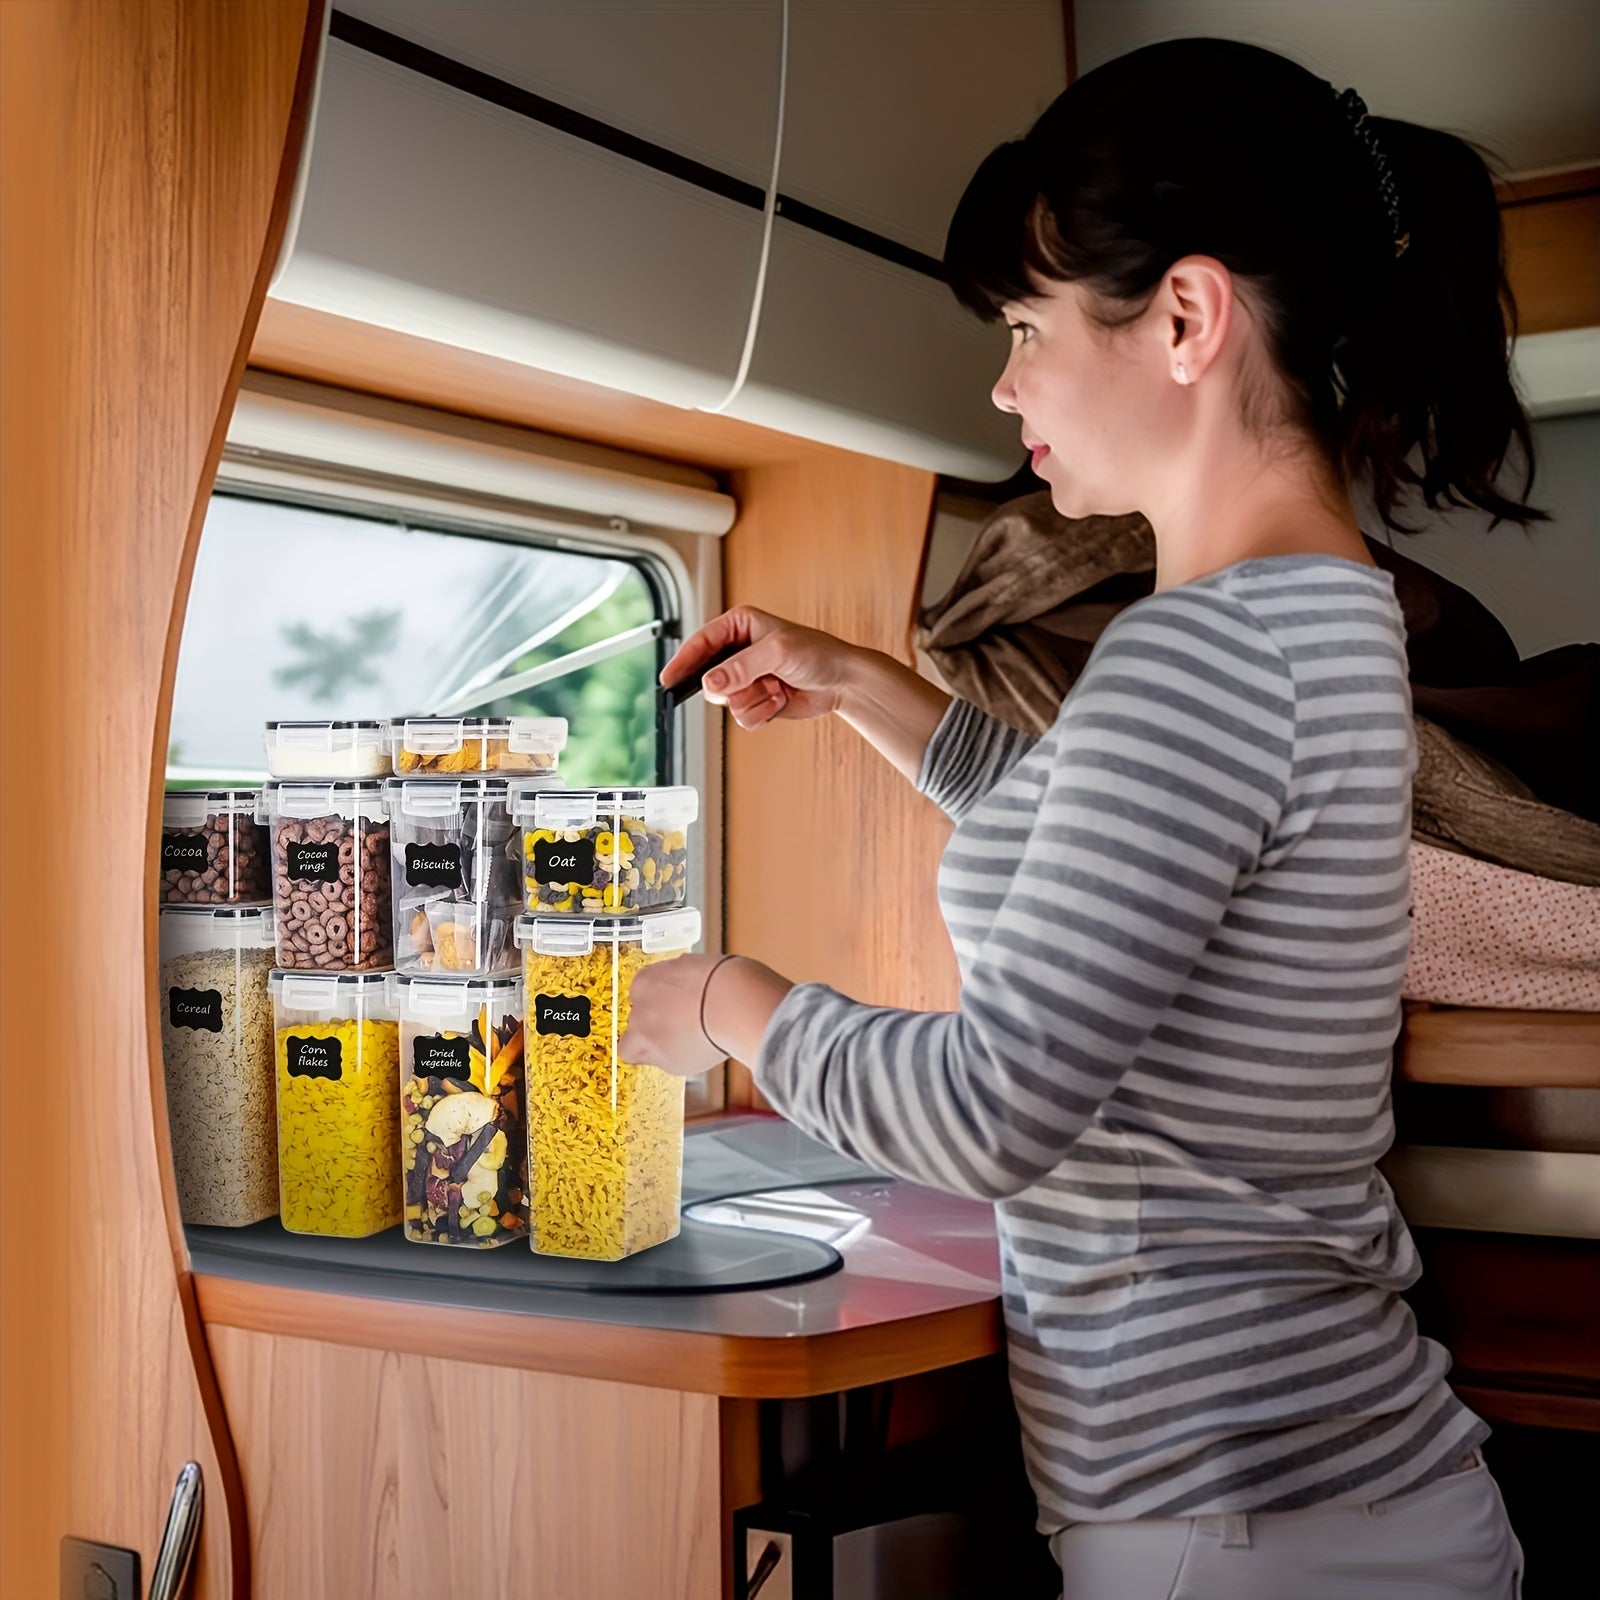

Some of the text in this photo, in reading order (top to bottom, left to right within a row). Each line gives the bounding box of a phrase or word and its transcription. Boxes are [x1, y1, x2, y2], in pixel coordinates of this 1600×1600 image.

[164, 845, 203, 858] Cocoa
[297, 850, 328, 860] Cocoa
[299, 860, 326, 873] rings
[412, 858, 456, 870] Biscuits
[548, 855, 577, 868] Oat
[176, 1002, 211, 1015] Cereal
[543, 1008, 581, 1022] Pasta
[300, 1044, 327, 1055] Corn
[429, 1048, 455, 1058] Dried
[297, 1054, 329, 1067] flakes
[420, 1058, 462, 1069] vegetable
